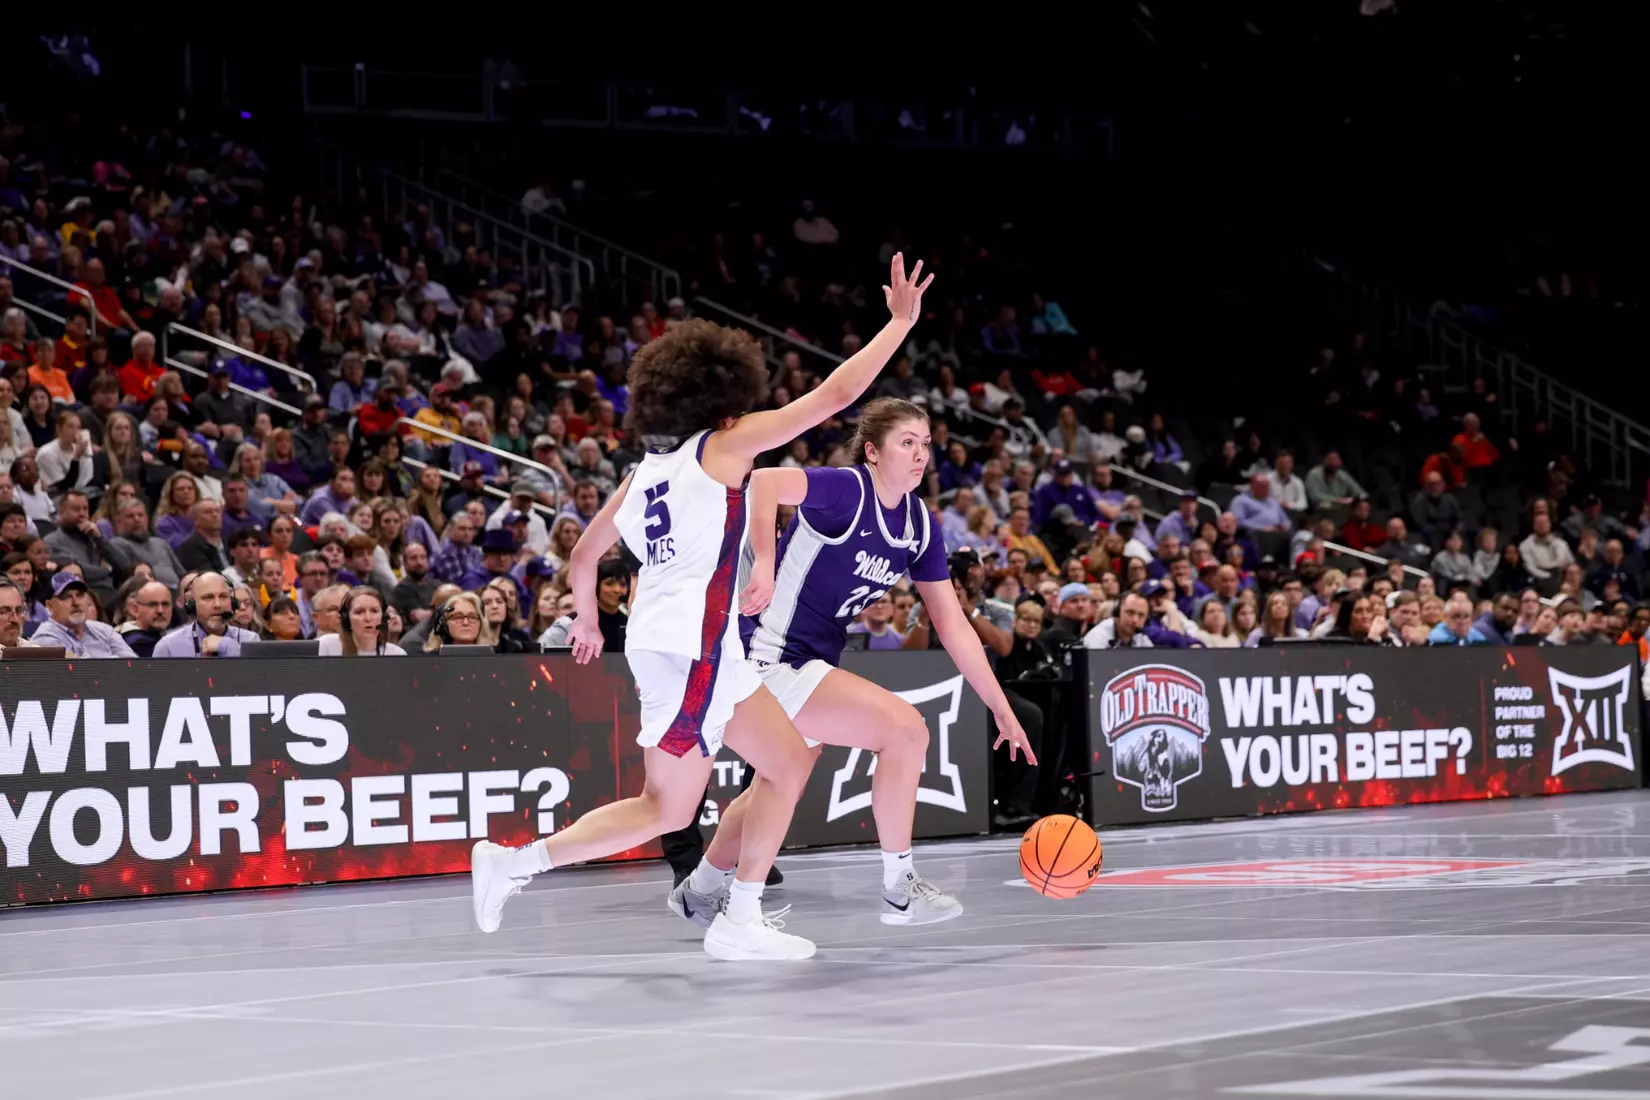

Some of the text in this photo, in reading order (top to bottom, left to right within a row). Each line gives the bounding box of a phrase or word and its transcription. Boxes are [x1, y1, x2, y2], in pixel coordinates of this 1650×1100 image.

[644, 480, 671, 541] 5
[852, 549, 904, 586] Wildca
[1101, 673, 1210, 735] OLD TRAPPER
[1218, 673, 1375, 728] WHAT'S
[1494, 686, 1533, 701] PROUD
[1494, 705, 1545, 720] PARTNER
[0, 692, 349, 775] WHAT'S
[1495, 724, 1535, 739] OF THE
[1496, 743, 1533, 759] BIG 12
[713, 760, 745, 787] TH
[1220, 727, 1473, 788] YOUR BEEF?
[0, 766, 570, 868] YOUR BEEF?
